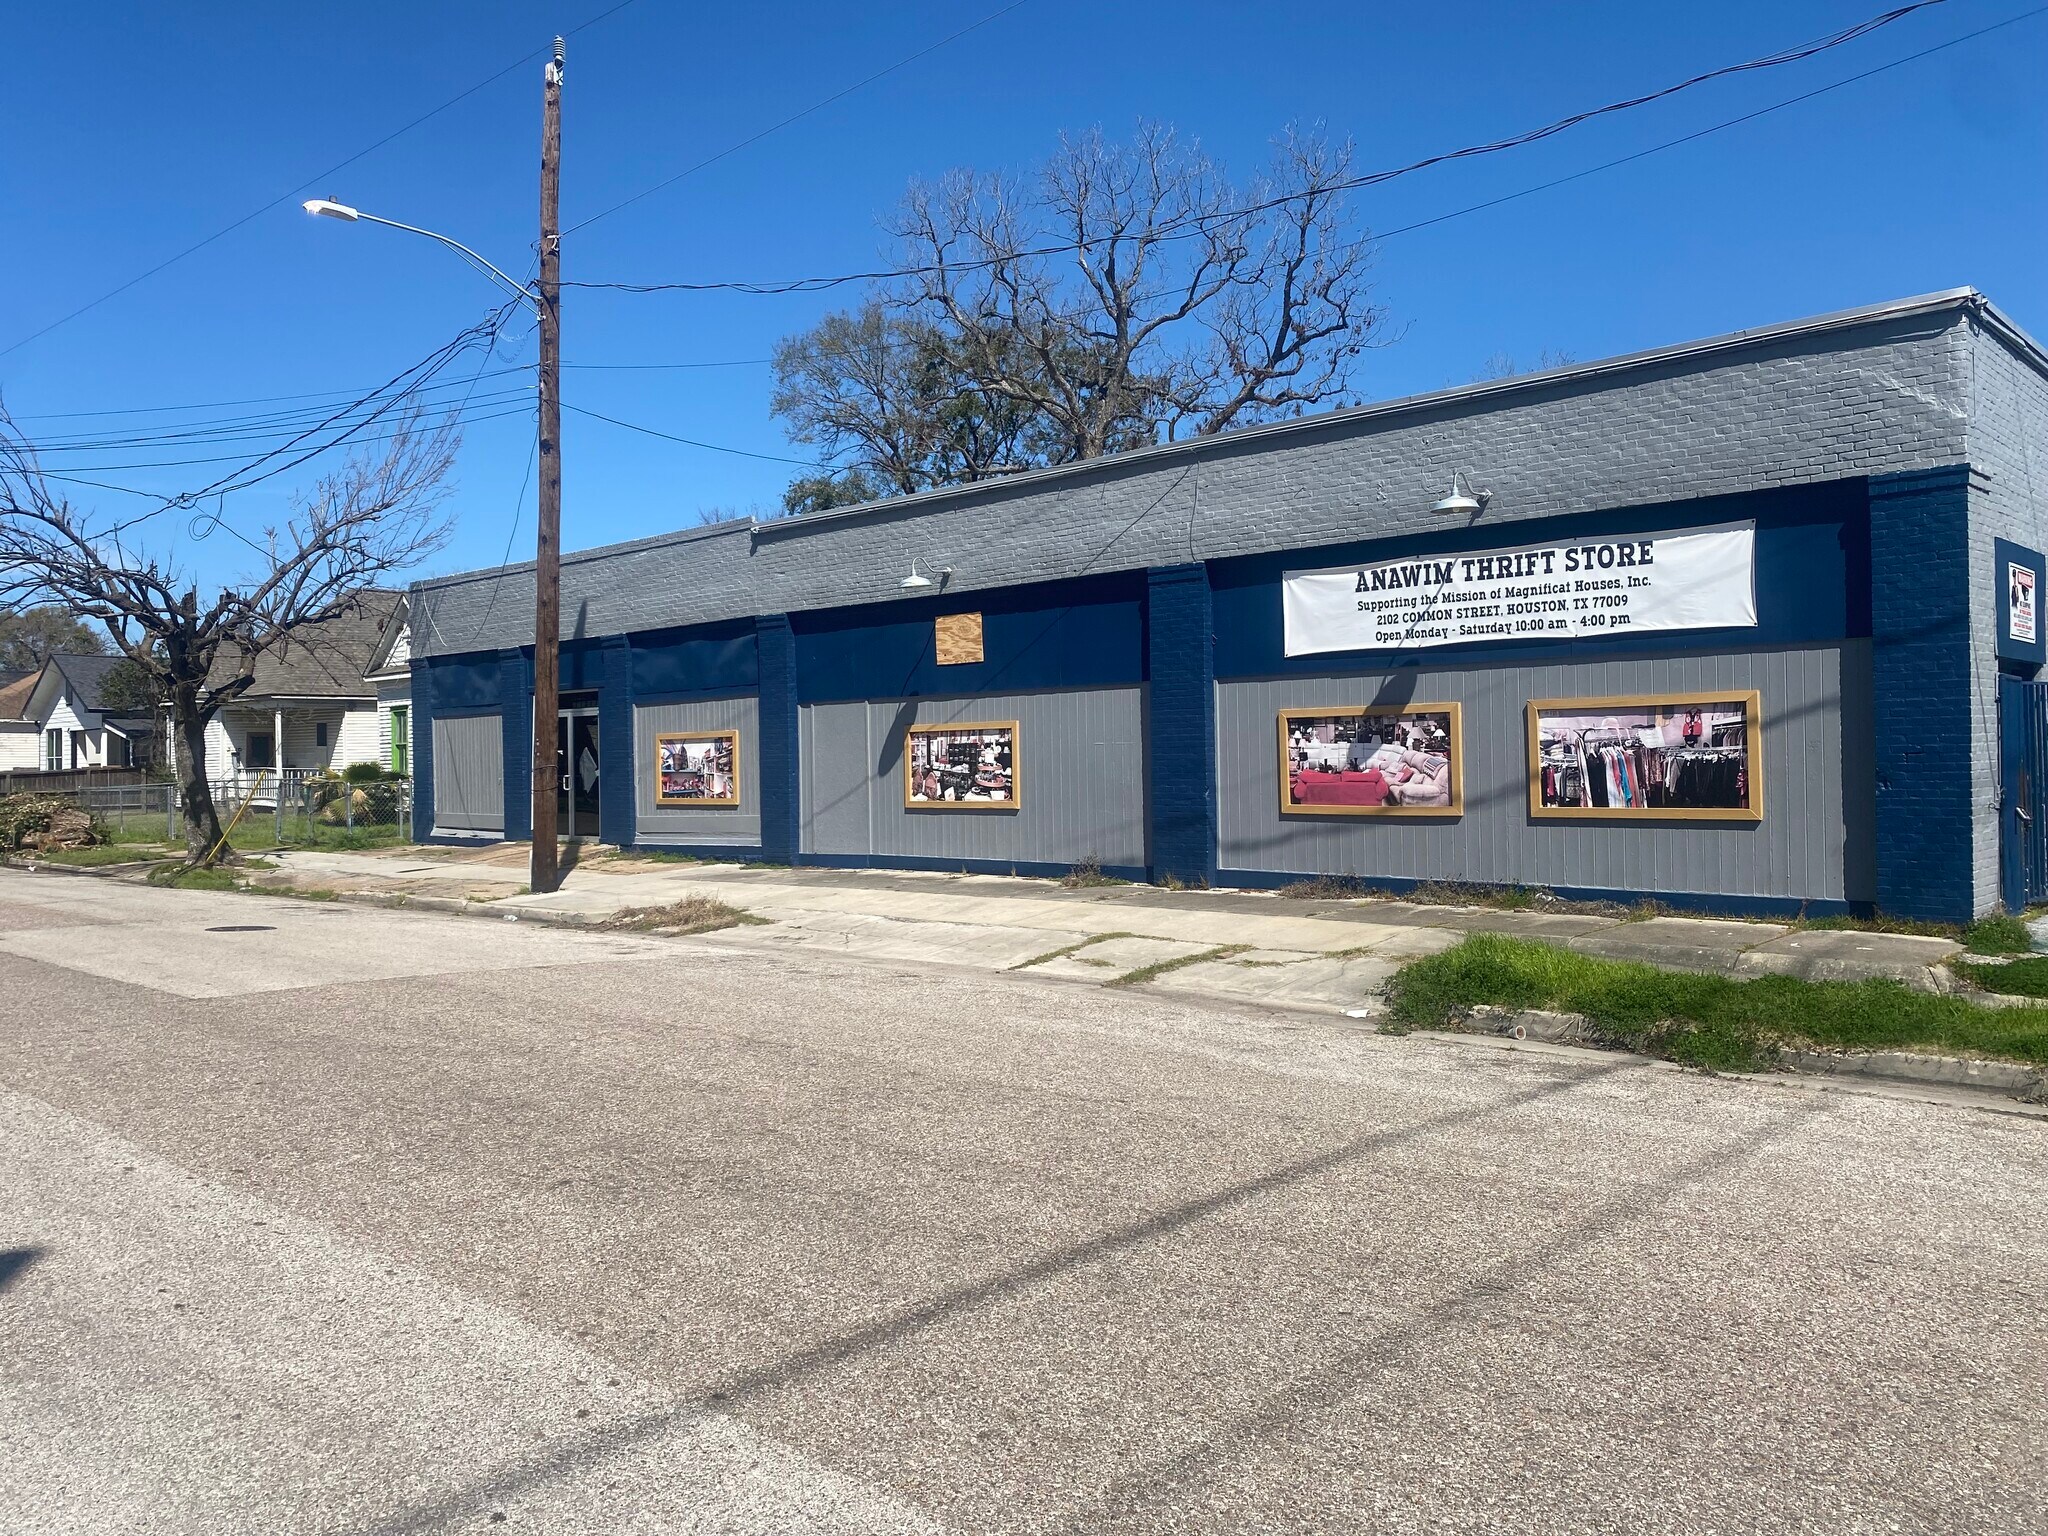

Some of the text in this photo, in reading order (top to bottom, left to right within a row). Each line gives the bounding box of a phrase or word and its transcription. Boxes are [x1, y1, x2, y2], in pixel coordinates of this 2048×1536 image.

[1355, 540, 1654, 592] ANAWIM THRIFT STORE
[1358, 576, 1652, 612] Supporting the Mission of Magnificat Houses, Inc.
[1377, 594, 1628, 625] 2102 COMMON STREET, HOUSTON, TX 77009
[1376, 631, 1402, 643] Open
[1405, 627, 1448, 639] Monday
[1460, 622, 1512, 634] Saturday
[1516, 619, 1544, 631] 10:00
[1548, 618, 1568, 629] am
[1580, 614, 1606, 626] 4:00
[1610, 614, 1631, 628] pm
